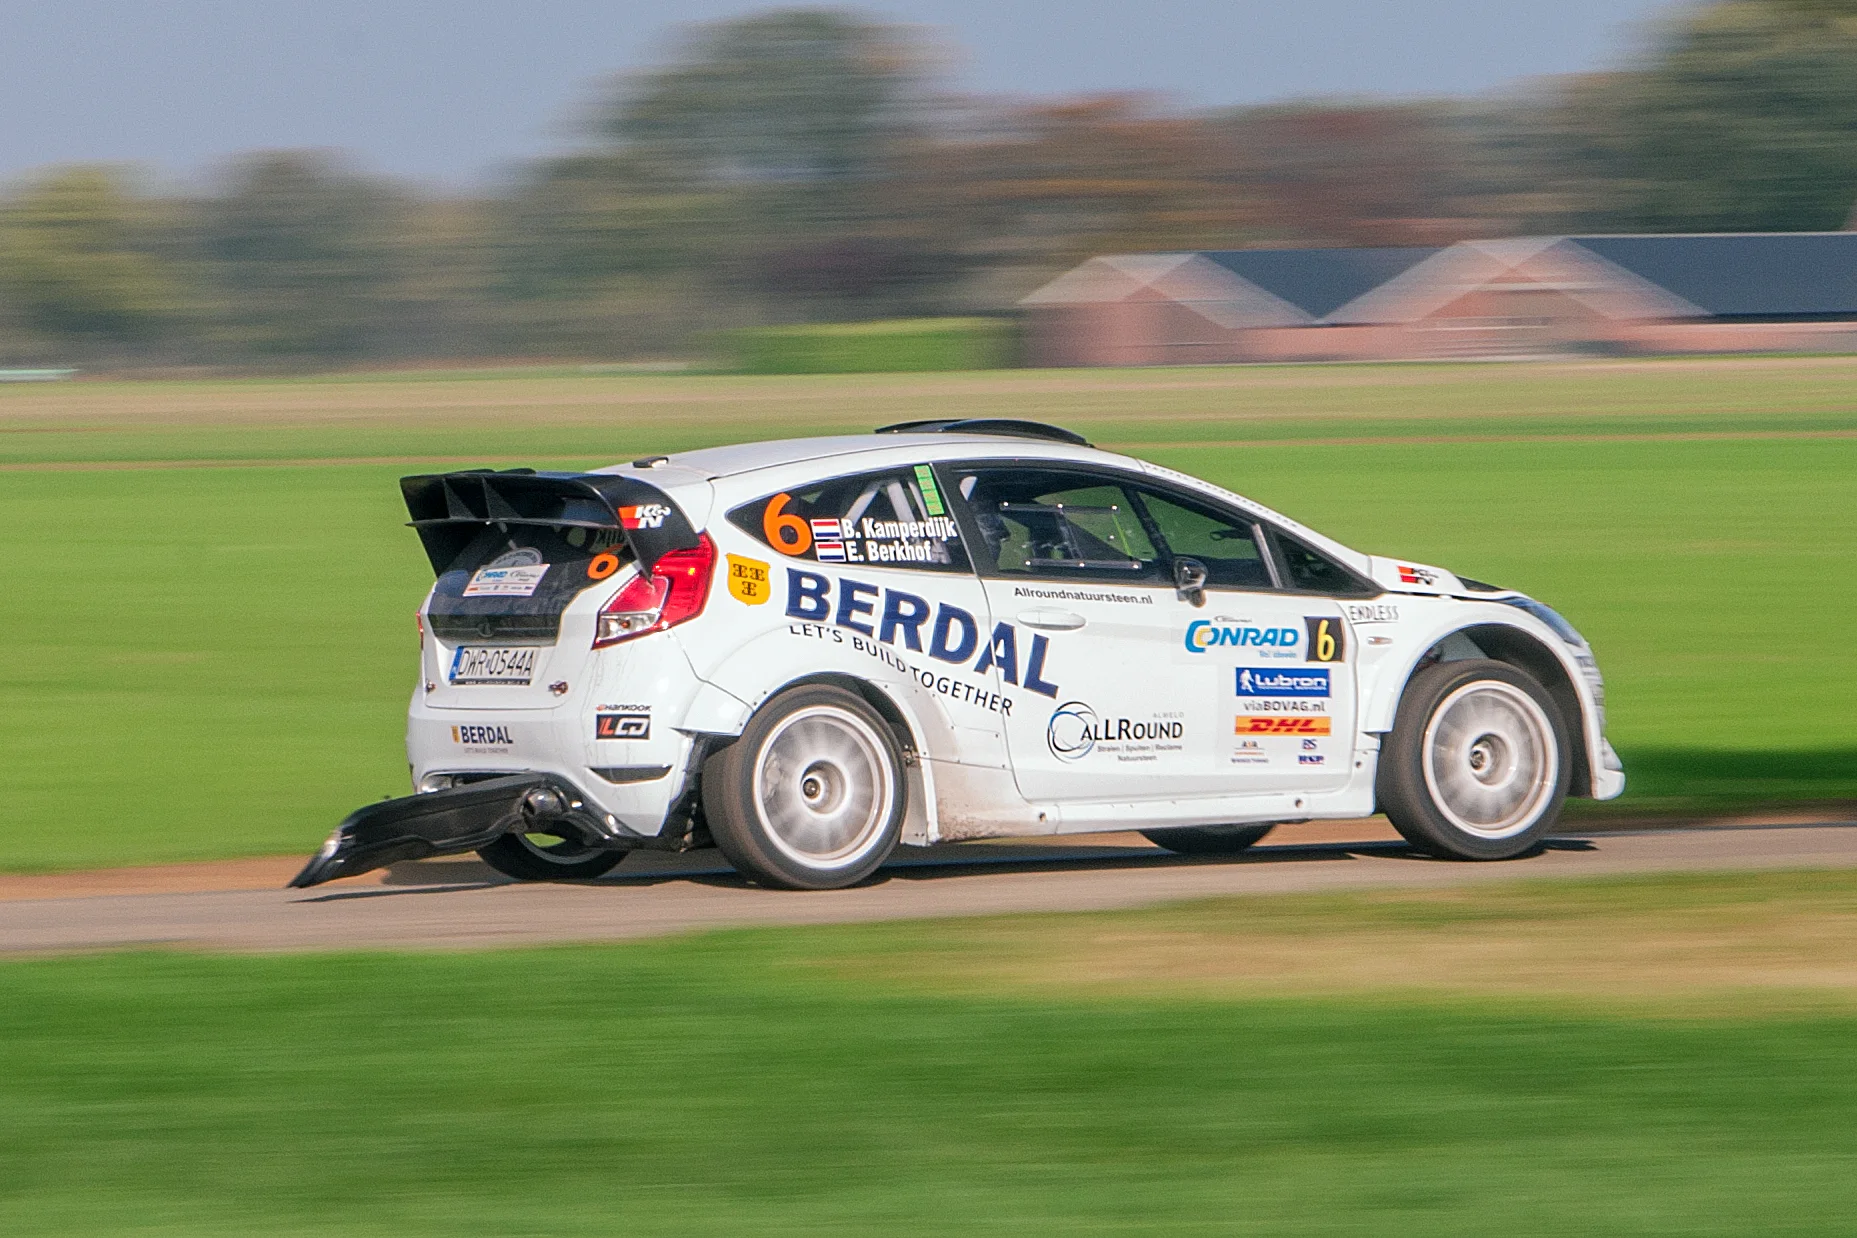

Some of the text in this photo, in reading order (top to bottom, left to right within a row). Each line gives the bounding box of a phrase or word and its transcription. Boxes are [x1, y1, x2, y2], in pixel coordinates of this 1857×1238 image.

[762, 492, 812, 556] 6
[842, 517, 957, 543] B. Kamperdijk
[847, 539, 932, 563] E. Berkhof
[1014, 587, 1154, 605] Allroundnatuursteen.nl
[1349, 605, 1400, 621] ENDLESS
[785, 567, 1060, 700] BERDAL
[1185, 620, 1299, 653] CONRAD
[1317, 619, 1336, 661] 6
[789, 624, 1013, 717] LET'S BUILD TOGETHER
[1254, 674, 1328, 689] Lubron
[1243, 700, 1326, 712] viaBOVAG.nl
[460, 725, 514, 745] BERDAL
[1248, 718, 1317, 732] DHL
